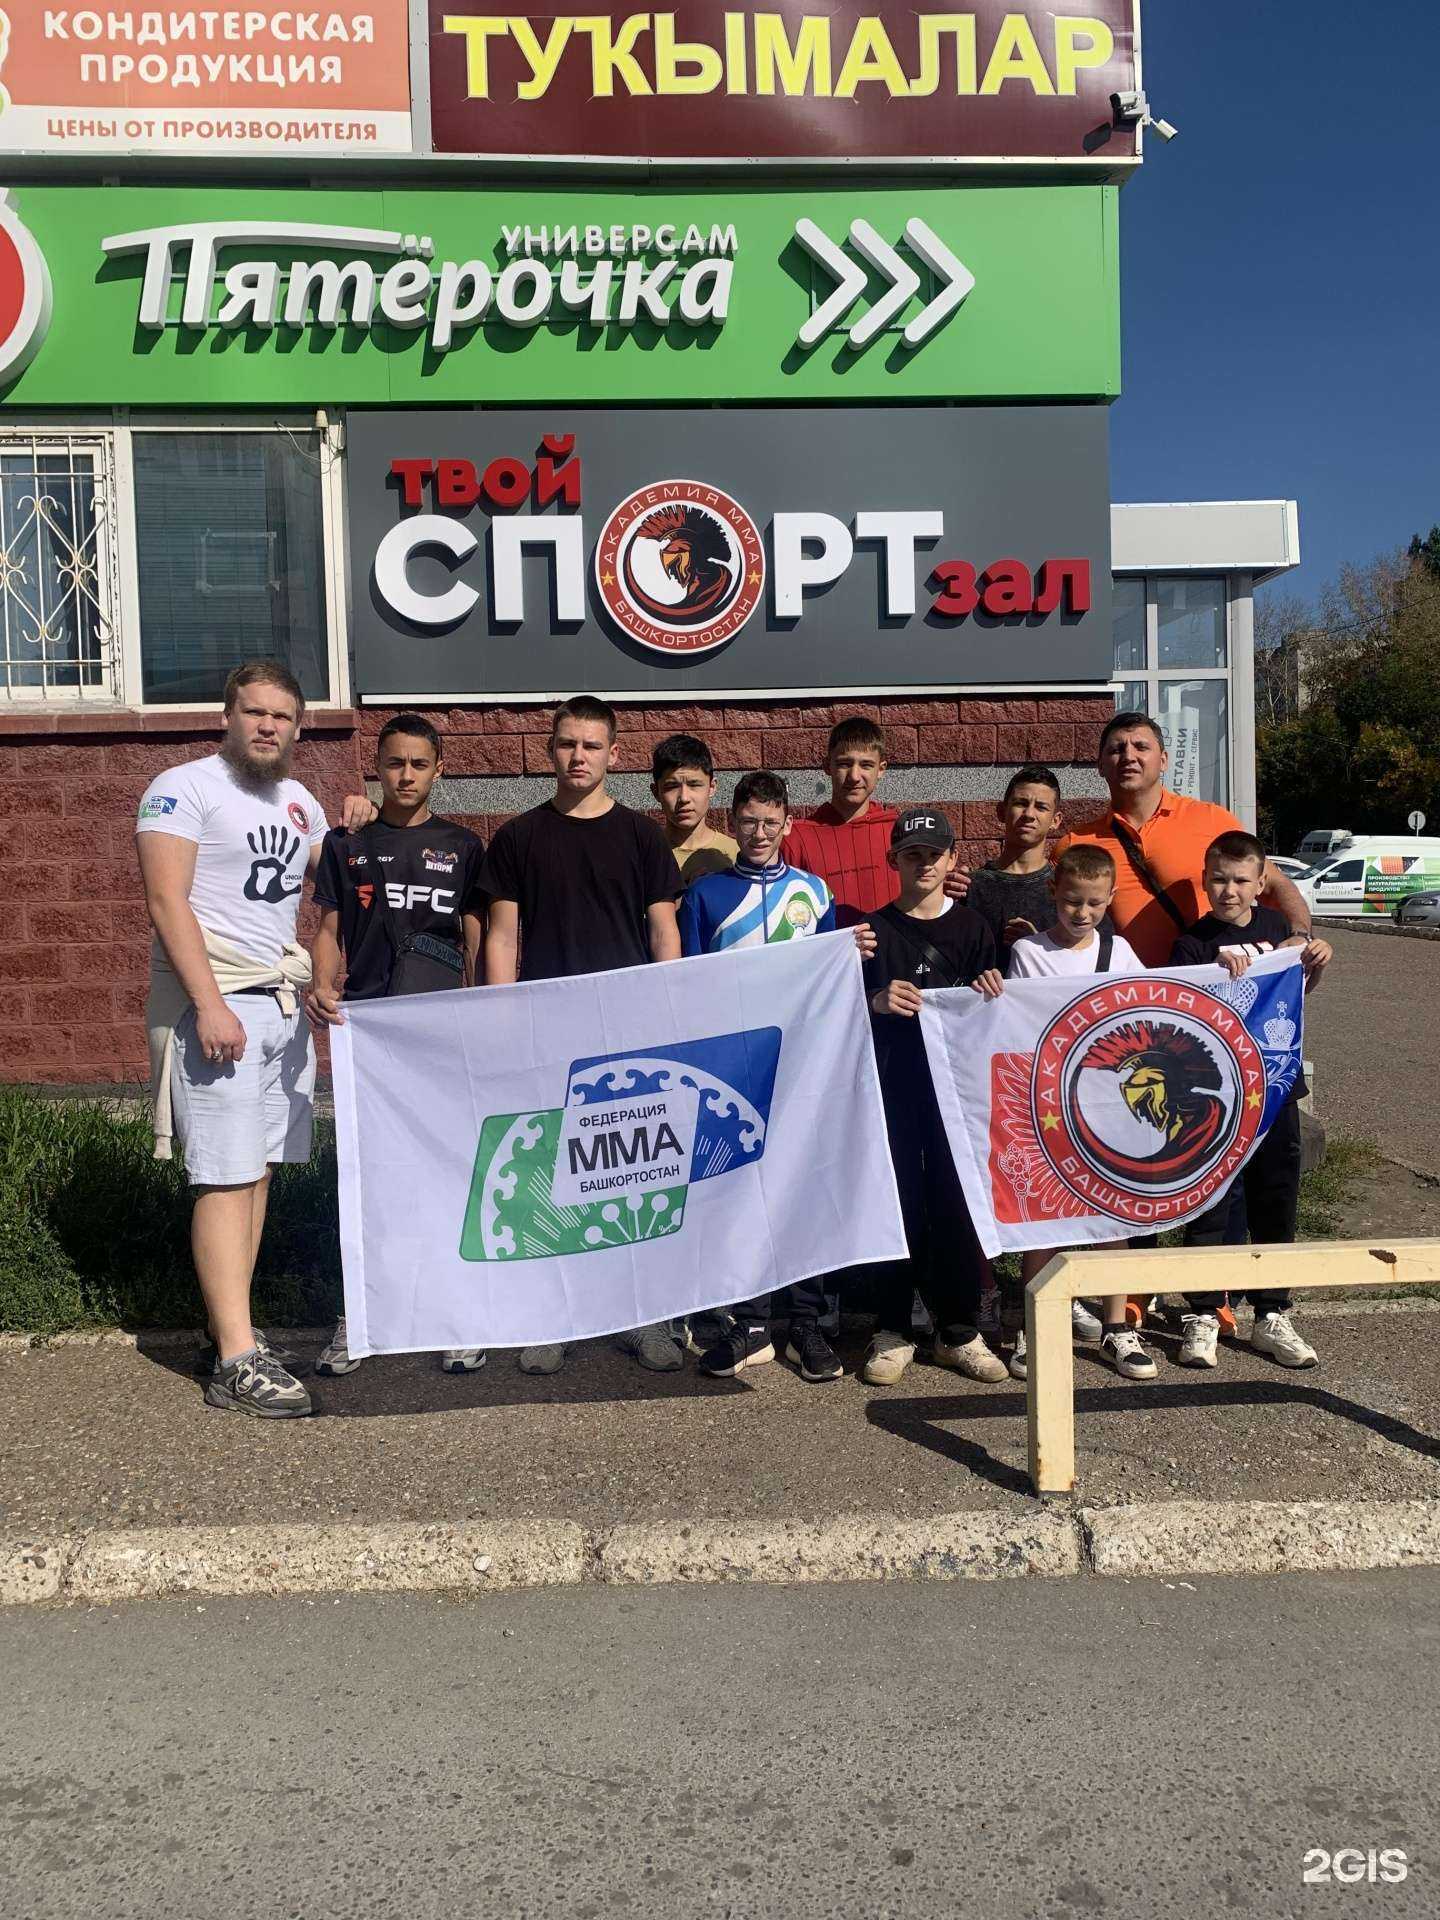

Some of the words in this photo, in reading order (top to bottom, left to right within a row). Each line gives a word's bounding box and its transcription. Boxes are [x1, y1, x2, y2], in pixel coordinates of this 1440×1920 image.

[43, 10, 374, 45] КОНДИТЕРСКАЯ
[79, 53, 343, 88] ПРОДУКЦИЯ
[46, 118, 118, 140] ЦЕНЫ
[123, 119, 157, 139] ОТ
[162, 120, 377, 143] ПРОИЗВОДИТЕЛЯ
[501, 223, 739, 257] УНИВЕРСАМ
[100, 220, 734, 354] Пятёрочка
[603, 485, 720, 565] АКАДЕМИЯ
[727, 507, 761, 564] ММА
[614, 598, 753, 646] БАШКОРТОСТАН
[903, 816, 936, 832] UFC
[425, 860, 454, 874] ШТОРМ
[384, 882, 456, 915] SFC
[1040, 985, 1196, 1105] АКАДЕМИЯ
[1211, 1007, 1260, 1088] ММА
[578, 1103, 668, 1128] ФЕДЕРАЦИЯ
[566, 1122, 685, 1175] ММА
[579, 1164, 681, 1194] БАШКОРТОСТАН
[1060, 1135, 1249, 1218] БАШКОРТОСТАН
